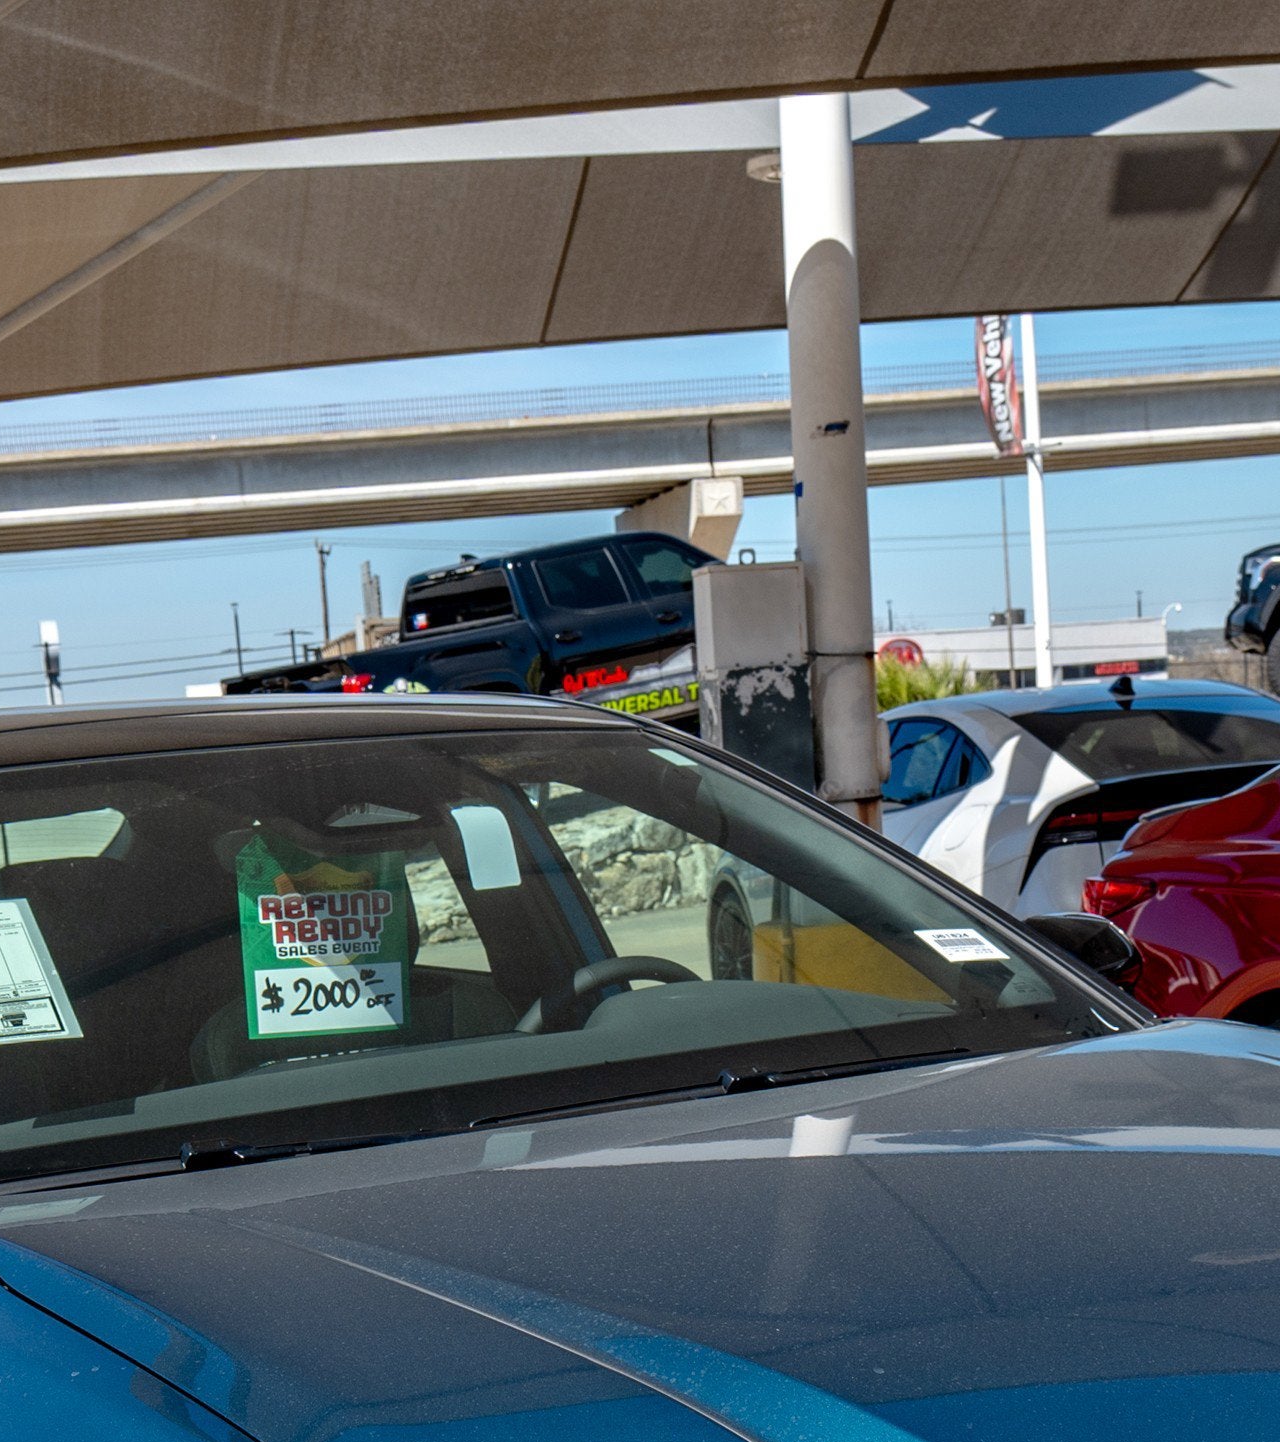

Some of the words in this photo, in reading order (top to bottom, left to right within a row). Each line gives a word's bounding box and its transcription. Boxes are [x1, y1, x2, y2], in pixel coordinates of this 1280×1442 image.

[990, 382, 1014, 442] New
[600, 686, 684, 714] VERSAL
[260, 892, 391, 921] REFUND
[275, 917, 382, 944] READY
[278, 944, 328, 957] SALES
[332, 941, 380, 954] EVENT
